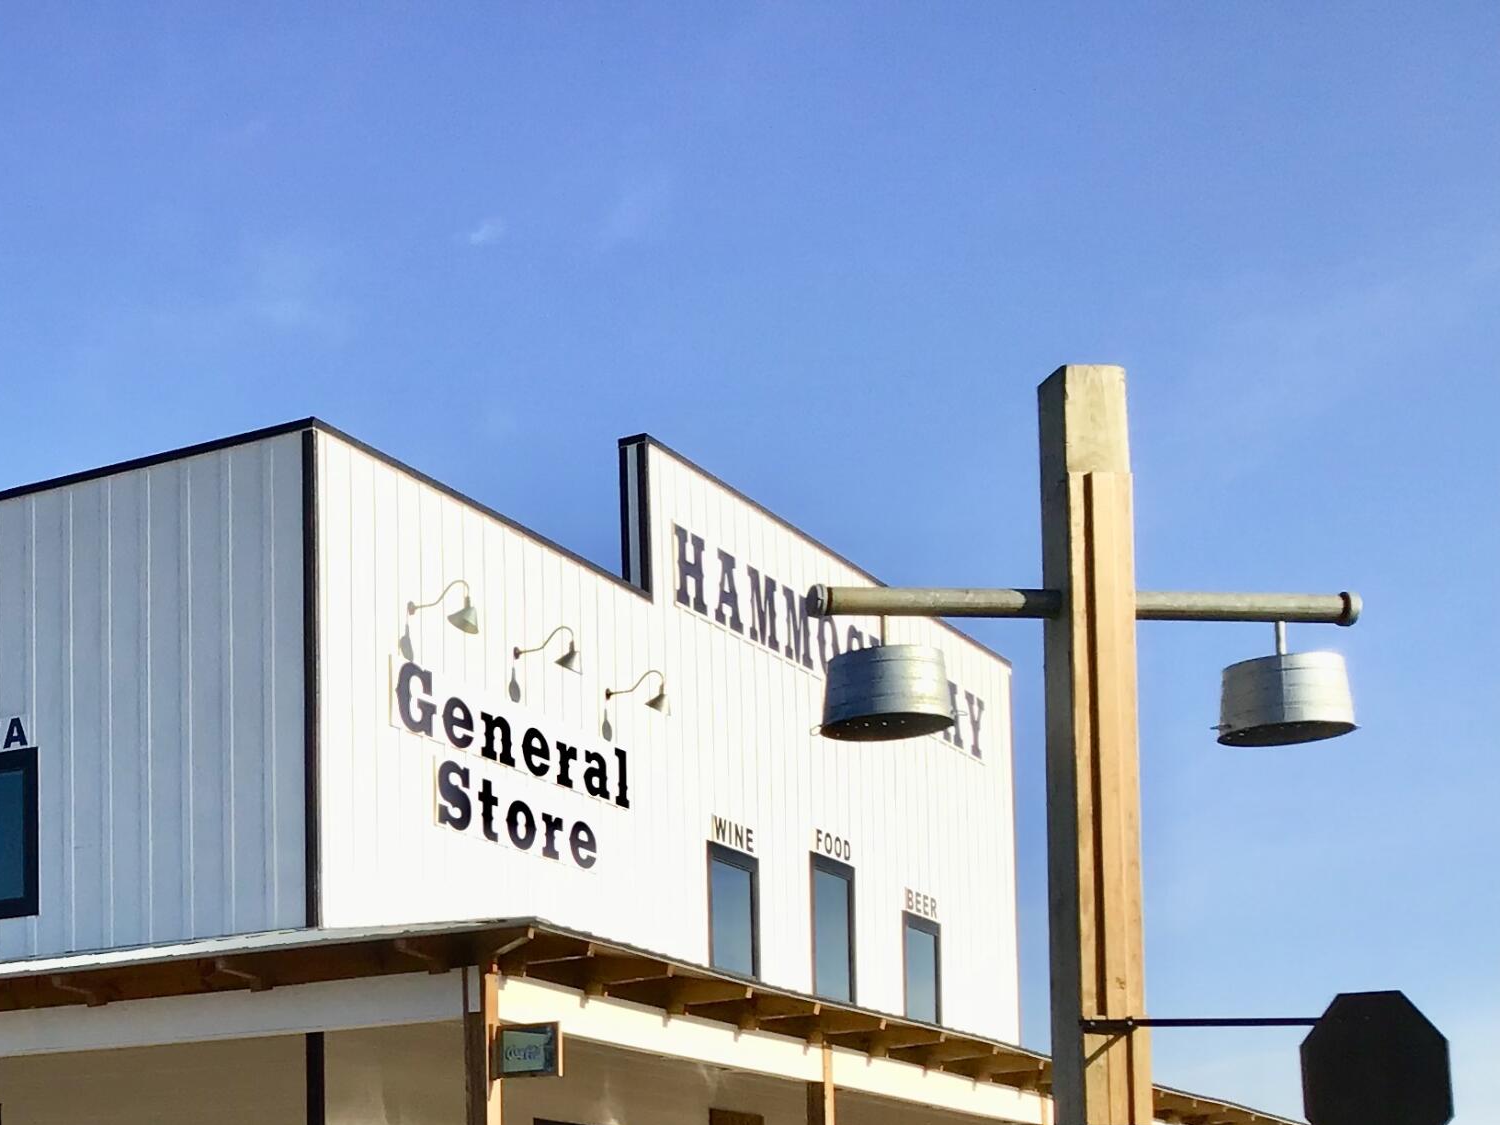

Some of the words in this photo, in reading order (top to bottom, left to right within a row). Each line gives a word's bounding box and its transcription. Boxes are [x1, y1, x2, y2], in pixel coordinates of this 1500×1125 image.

[673, 522, 884, 676] HAMMO
[395, 661, 631, 810] General
[437, 760, 597, 869] Store
[713, 815, 755, 853] WINE
[815, 828, 851, 861] FOOD
[905, 888, 938, 919] BEER
